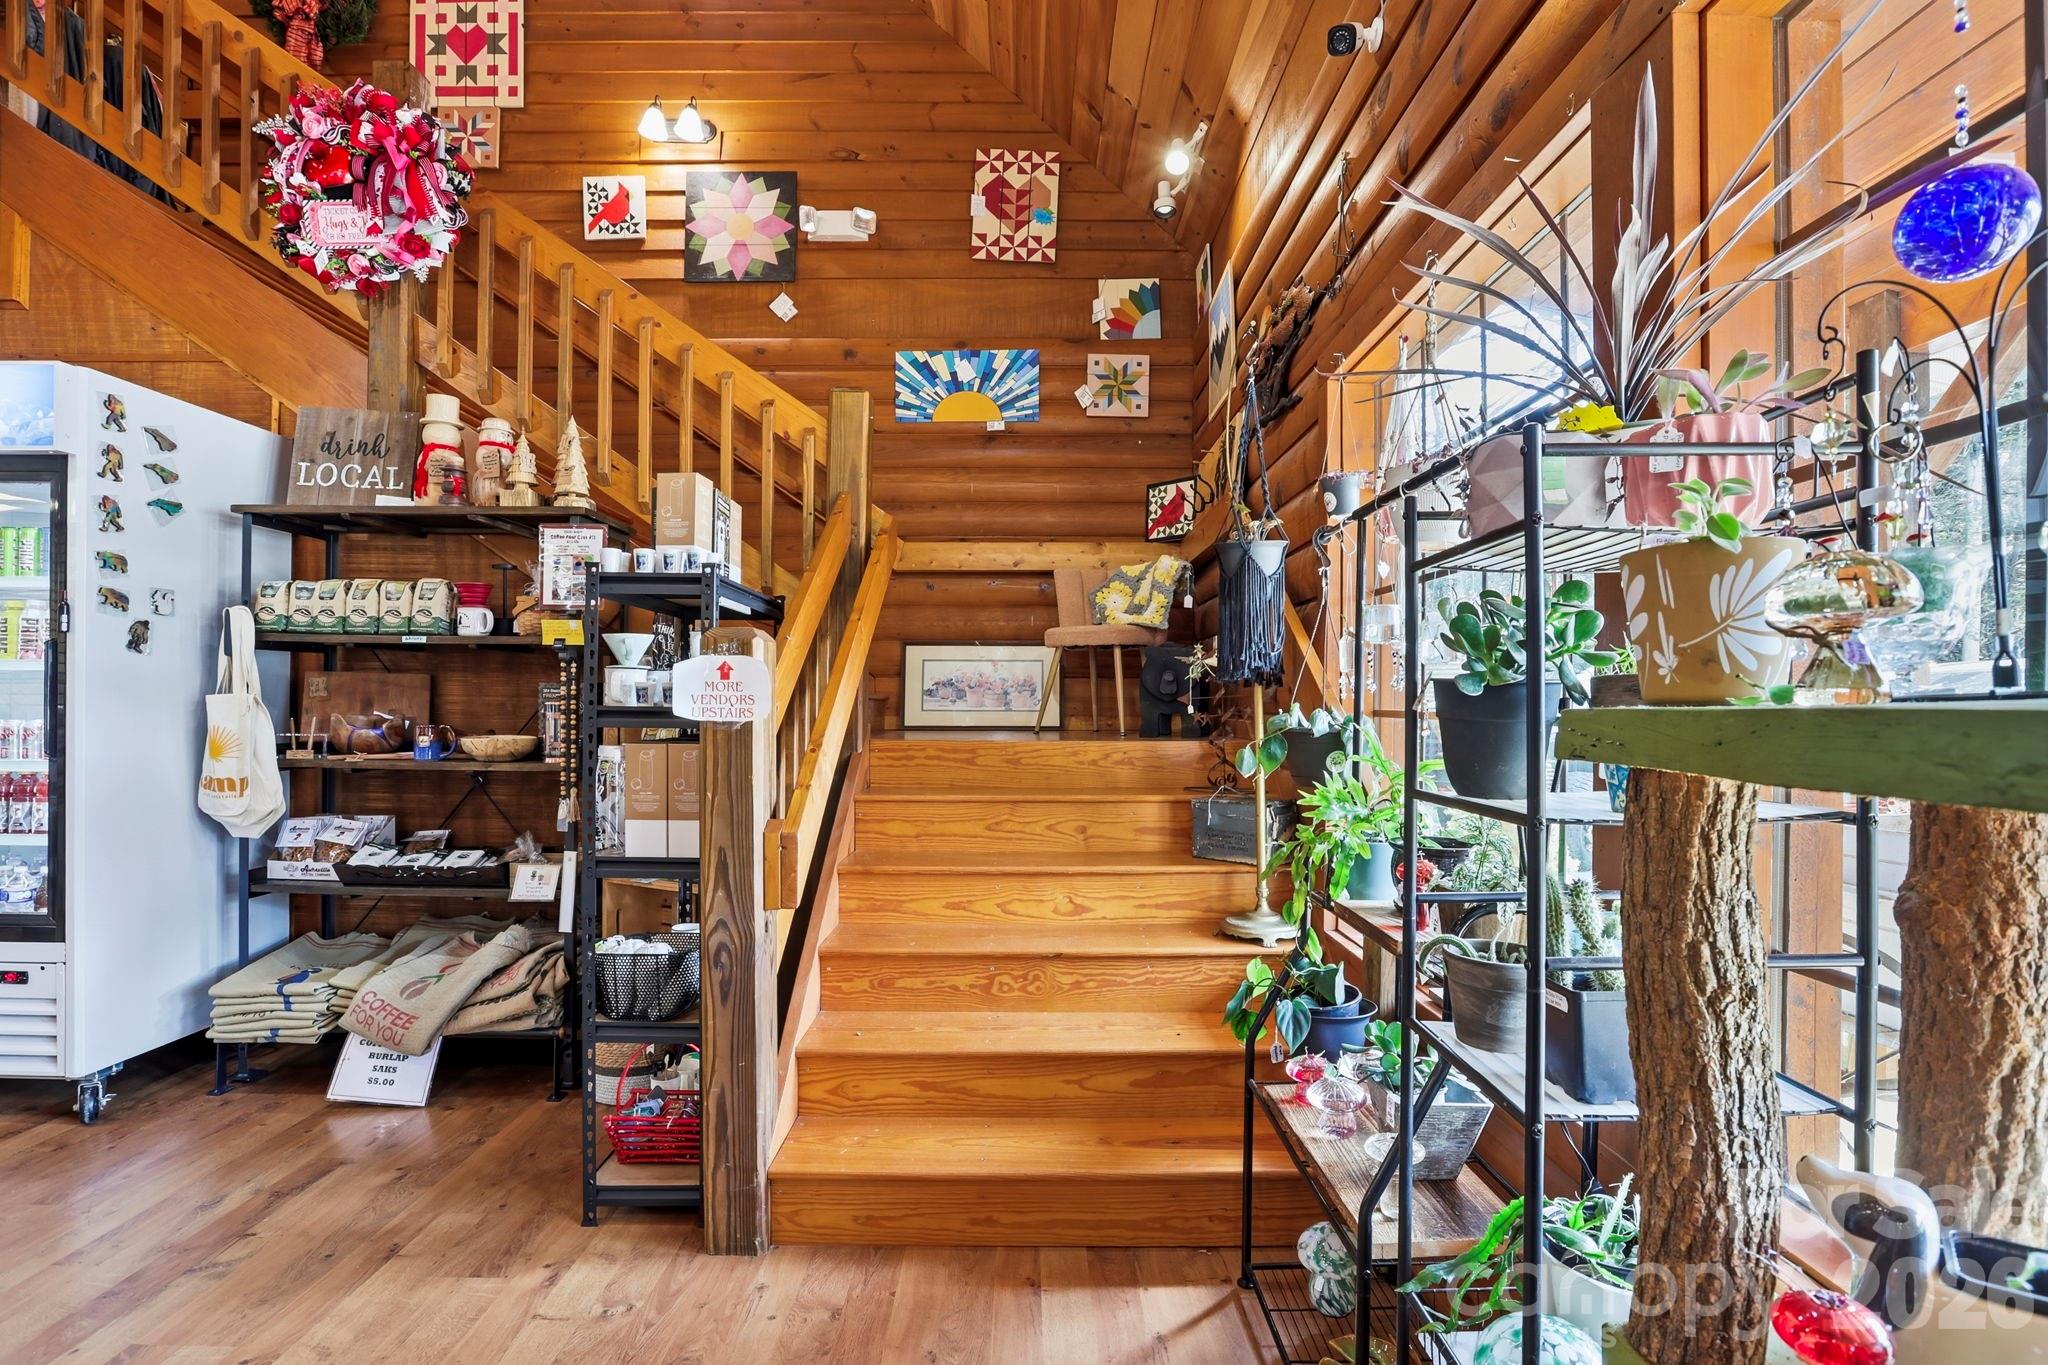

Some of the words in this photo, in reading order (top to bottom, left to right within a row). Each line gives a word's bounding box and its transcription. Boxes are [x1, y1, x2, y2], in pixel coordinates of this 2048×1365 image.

[320, 430, 391, 460] drink
[296, 461, 404, 491] LOCAL
[20, 617, 40, 655] PRIME
[704, 681, 744, 692] MORE
[691, 694, 756, 706] VENDORS
[691, 707, 754, 718] UPSTAIRS
[361, 990, 421, 1031] COFFEE
[350, 1003, 374, 1030] FOR
[375, 1021, 406, 1047] YOU
[368, 1051, 409, 1062] BURLAP
[371, 1065, 397, 1074] SAKS
[367, 1077, 395, 1086] $5.00
